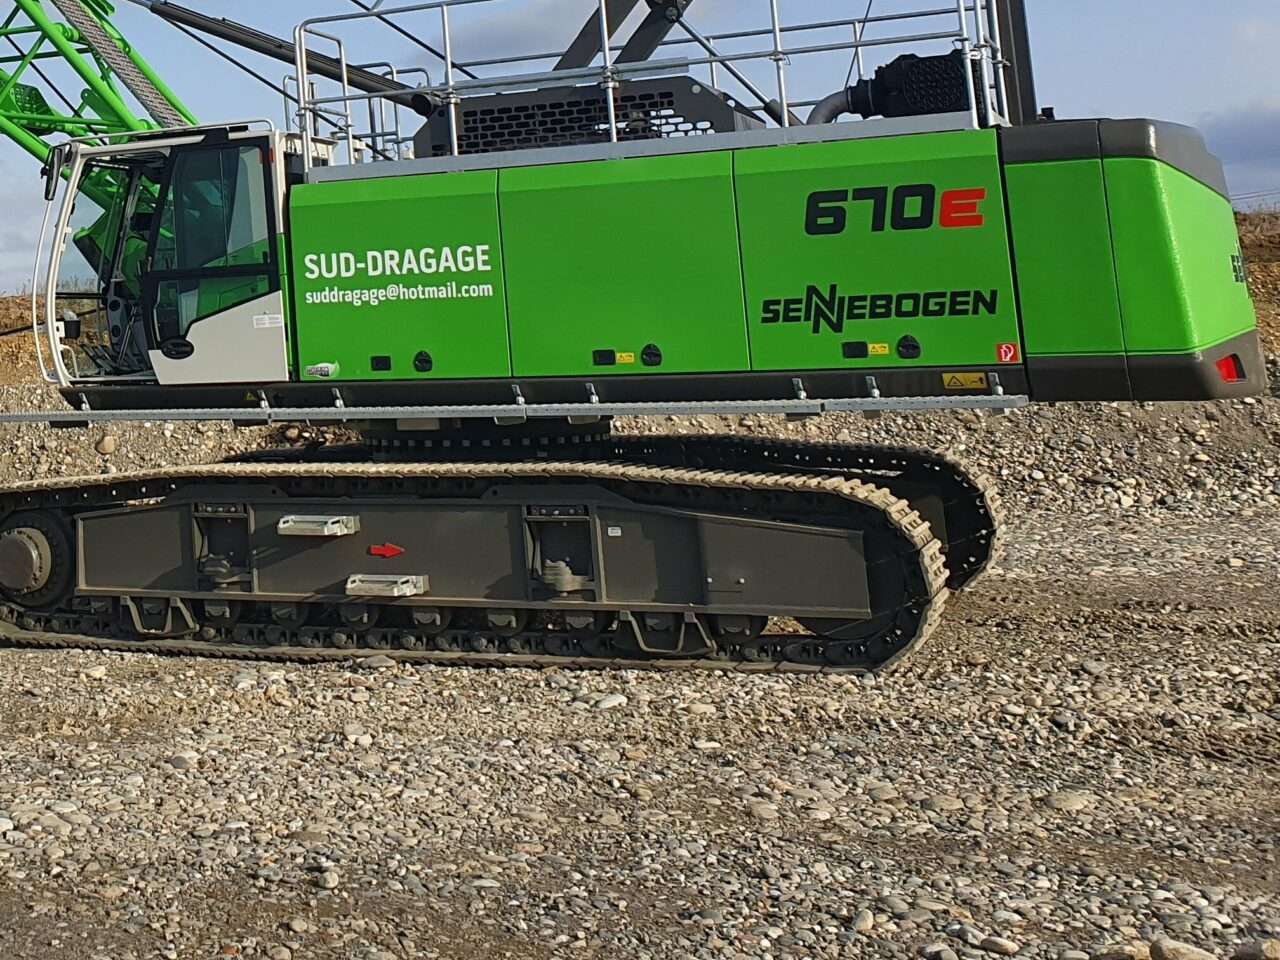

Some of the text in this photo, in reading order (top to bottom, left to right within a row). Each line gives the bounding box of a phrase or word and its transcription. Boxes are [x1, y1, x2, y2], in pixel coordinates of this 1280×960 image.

[804, 183, 986, 235] 670E
[304, 245, 492, 279] SUD-DRAGAGE
[305, 281, 493, 306] suddragage@hotmail.com
[760, 284, 998, 334] SENNEBOGEN
